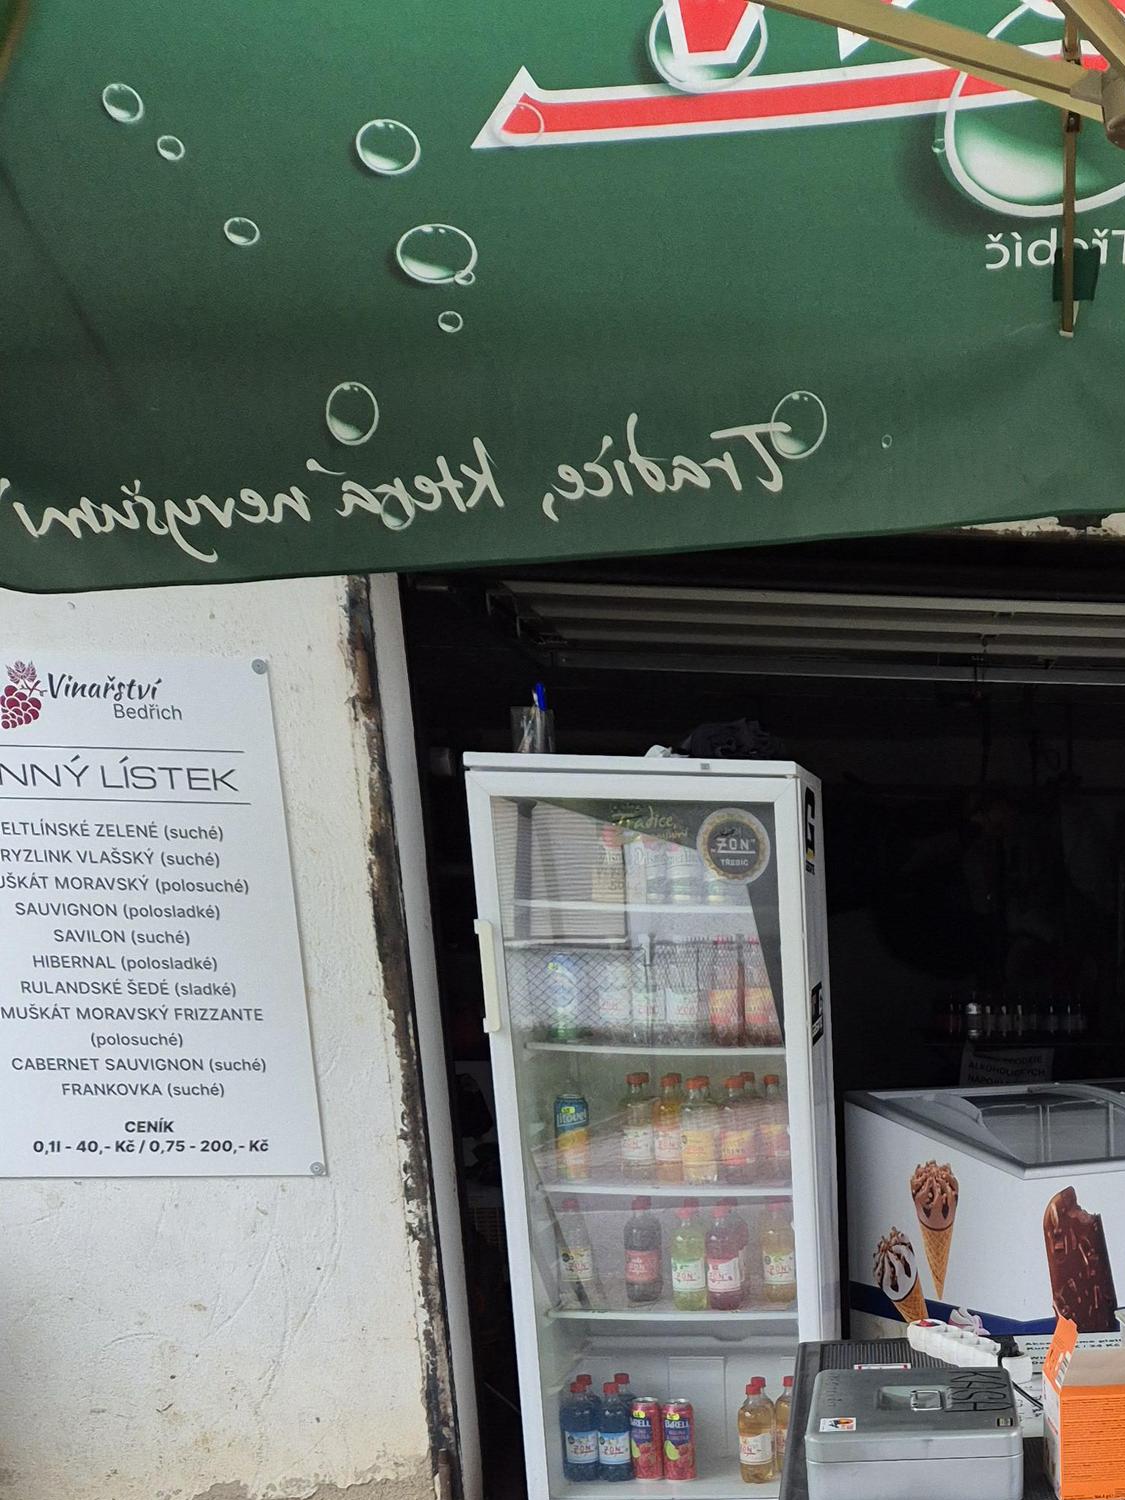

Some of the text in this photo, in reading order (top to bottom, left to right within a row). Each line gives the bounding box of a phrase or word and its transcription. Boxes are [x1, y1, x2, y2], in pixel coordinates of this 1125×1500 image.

[48, 673, 162, 700] Vinařství
[113, 703, 183, 721] Bedřich
[0, 754, 239, 792] NNÝ LÍSTEK
[1, 818, 223, 842] ELTLÍNSKÉ ZELENÉ (suché)
[1, 847, 220, 868] RYZLINK VLAŠSKÝ (suché)
[0, 871, 249, 895] UŠKÁT MORAVSKÝ (polosuché)
[15, 902, 221, 921] SAUVIGNON (polosladké)
[53, 929, 191, 946] SAVILON (suché)
[32, 955, 218, 973] HIBERNAL (polosladké)
[20, 978, 236, 998] RULANDSKÉ ŠEDÉ (sladké)
[1, 1004, 264, 1021] MUŠKÁT MORAVSKÝ FRIZZANTE
[90, 1032, 184, 1048] (polosuché)
[11, 1057, 267, 1074] CABERNET SAUVIGNON (suché)
[61, 1083, 225, 1098] FRANKOVKA (suché)
[124, 1117, 174, 1133] CENÍK
[115, 1139, 135, 1153] Kč
[149, 1140, 185, 1155] 0,75
[249, 1139, 269, 1152] Kč
